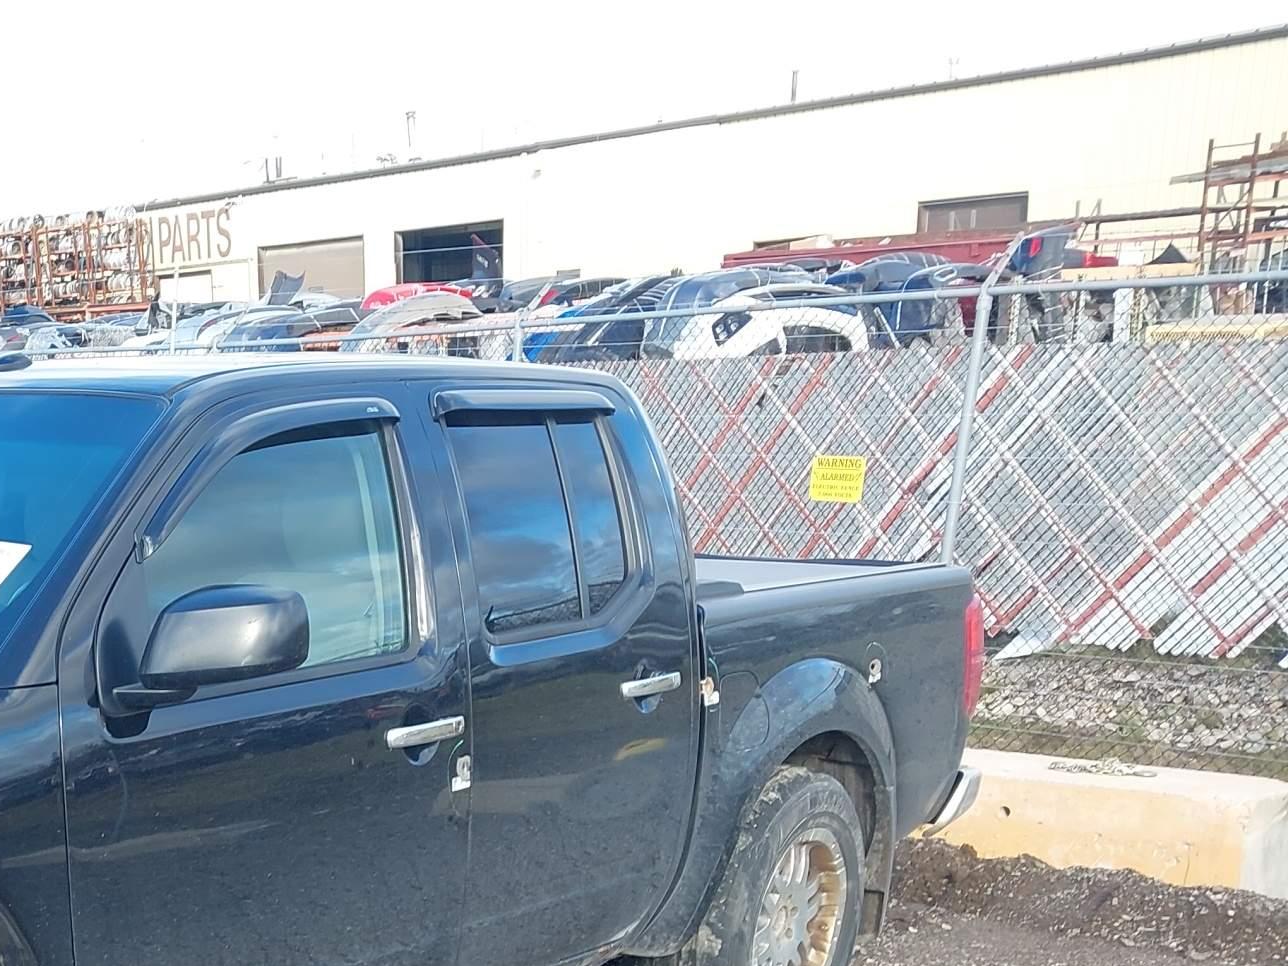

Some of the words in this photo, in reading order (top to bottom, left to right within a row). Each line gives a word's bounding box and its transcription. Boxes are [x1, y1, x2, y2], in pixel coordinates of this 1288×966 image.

[158, 207, 231, 264] PARTS
[817, 458, 862, 468] WARNING
[820, 473, 855, 481] ALARMED
